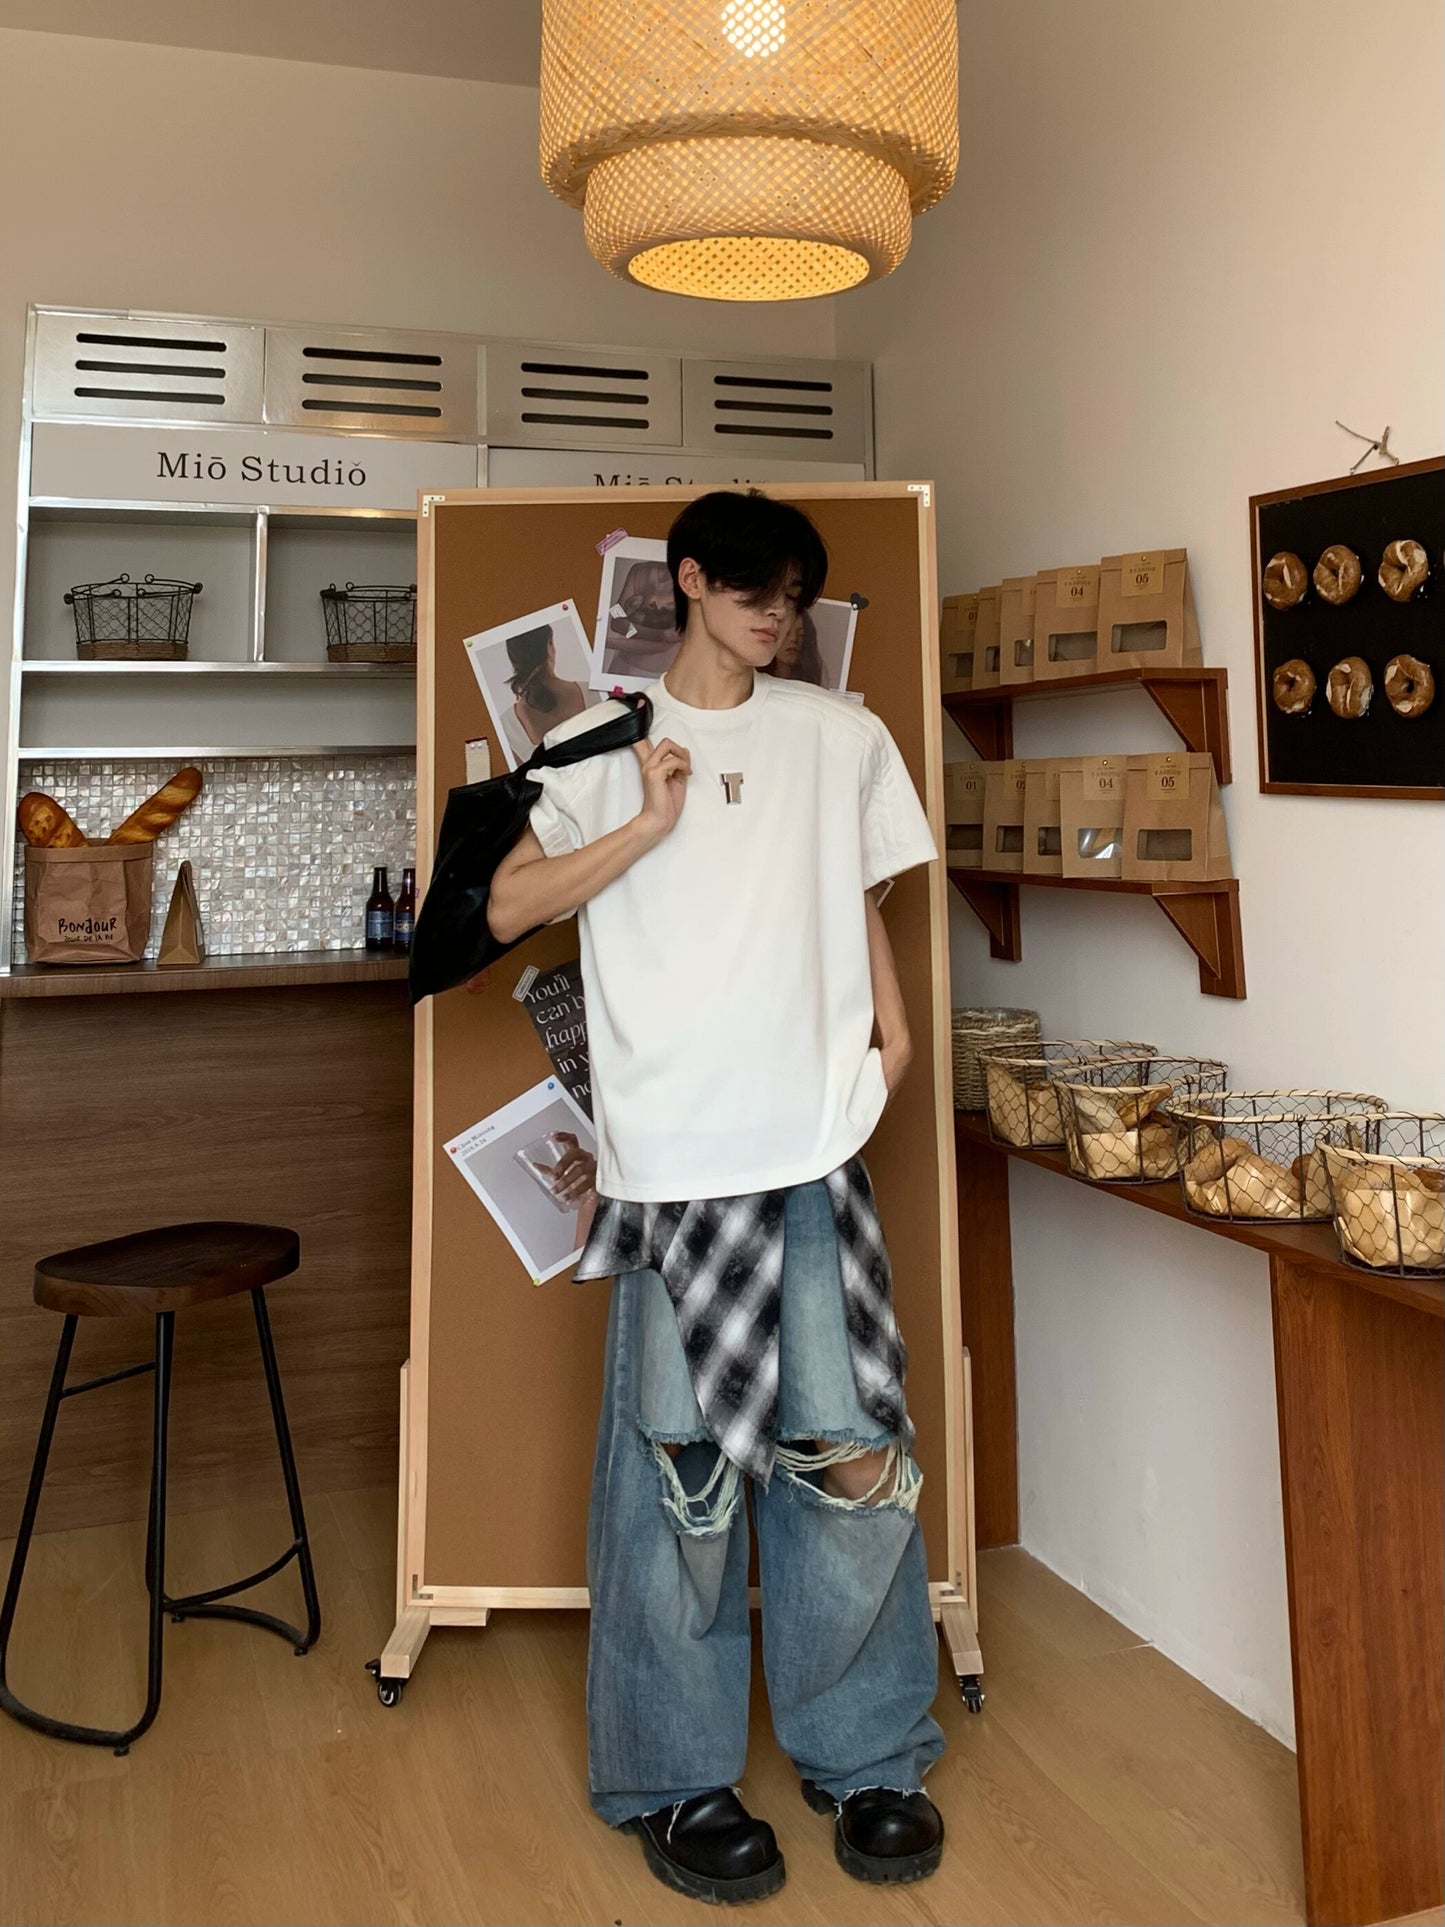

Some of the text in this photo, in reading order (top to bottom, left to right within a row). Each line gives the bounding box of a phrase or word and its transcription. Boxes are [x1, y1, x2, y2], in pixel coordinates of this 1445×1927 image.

[157, 452, 227, 480] Miō
[1135, 573, 1149, 584] 05
[1070, 586, 1084, 597] 04
[965, 781, 977, 791] 01
[1098, 778, 1113, 789] 04
[1161, 776, 1175, 788] 05
[58, 917, 118, 935] BONJOUR
[536, 1001, 571, 1024] can
[556, 1058, 578, 1074] in
